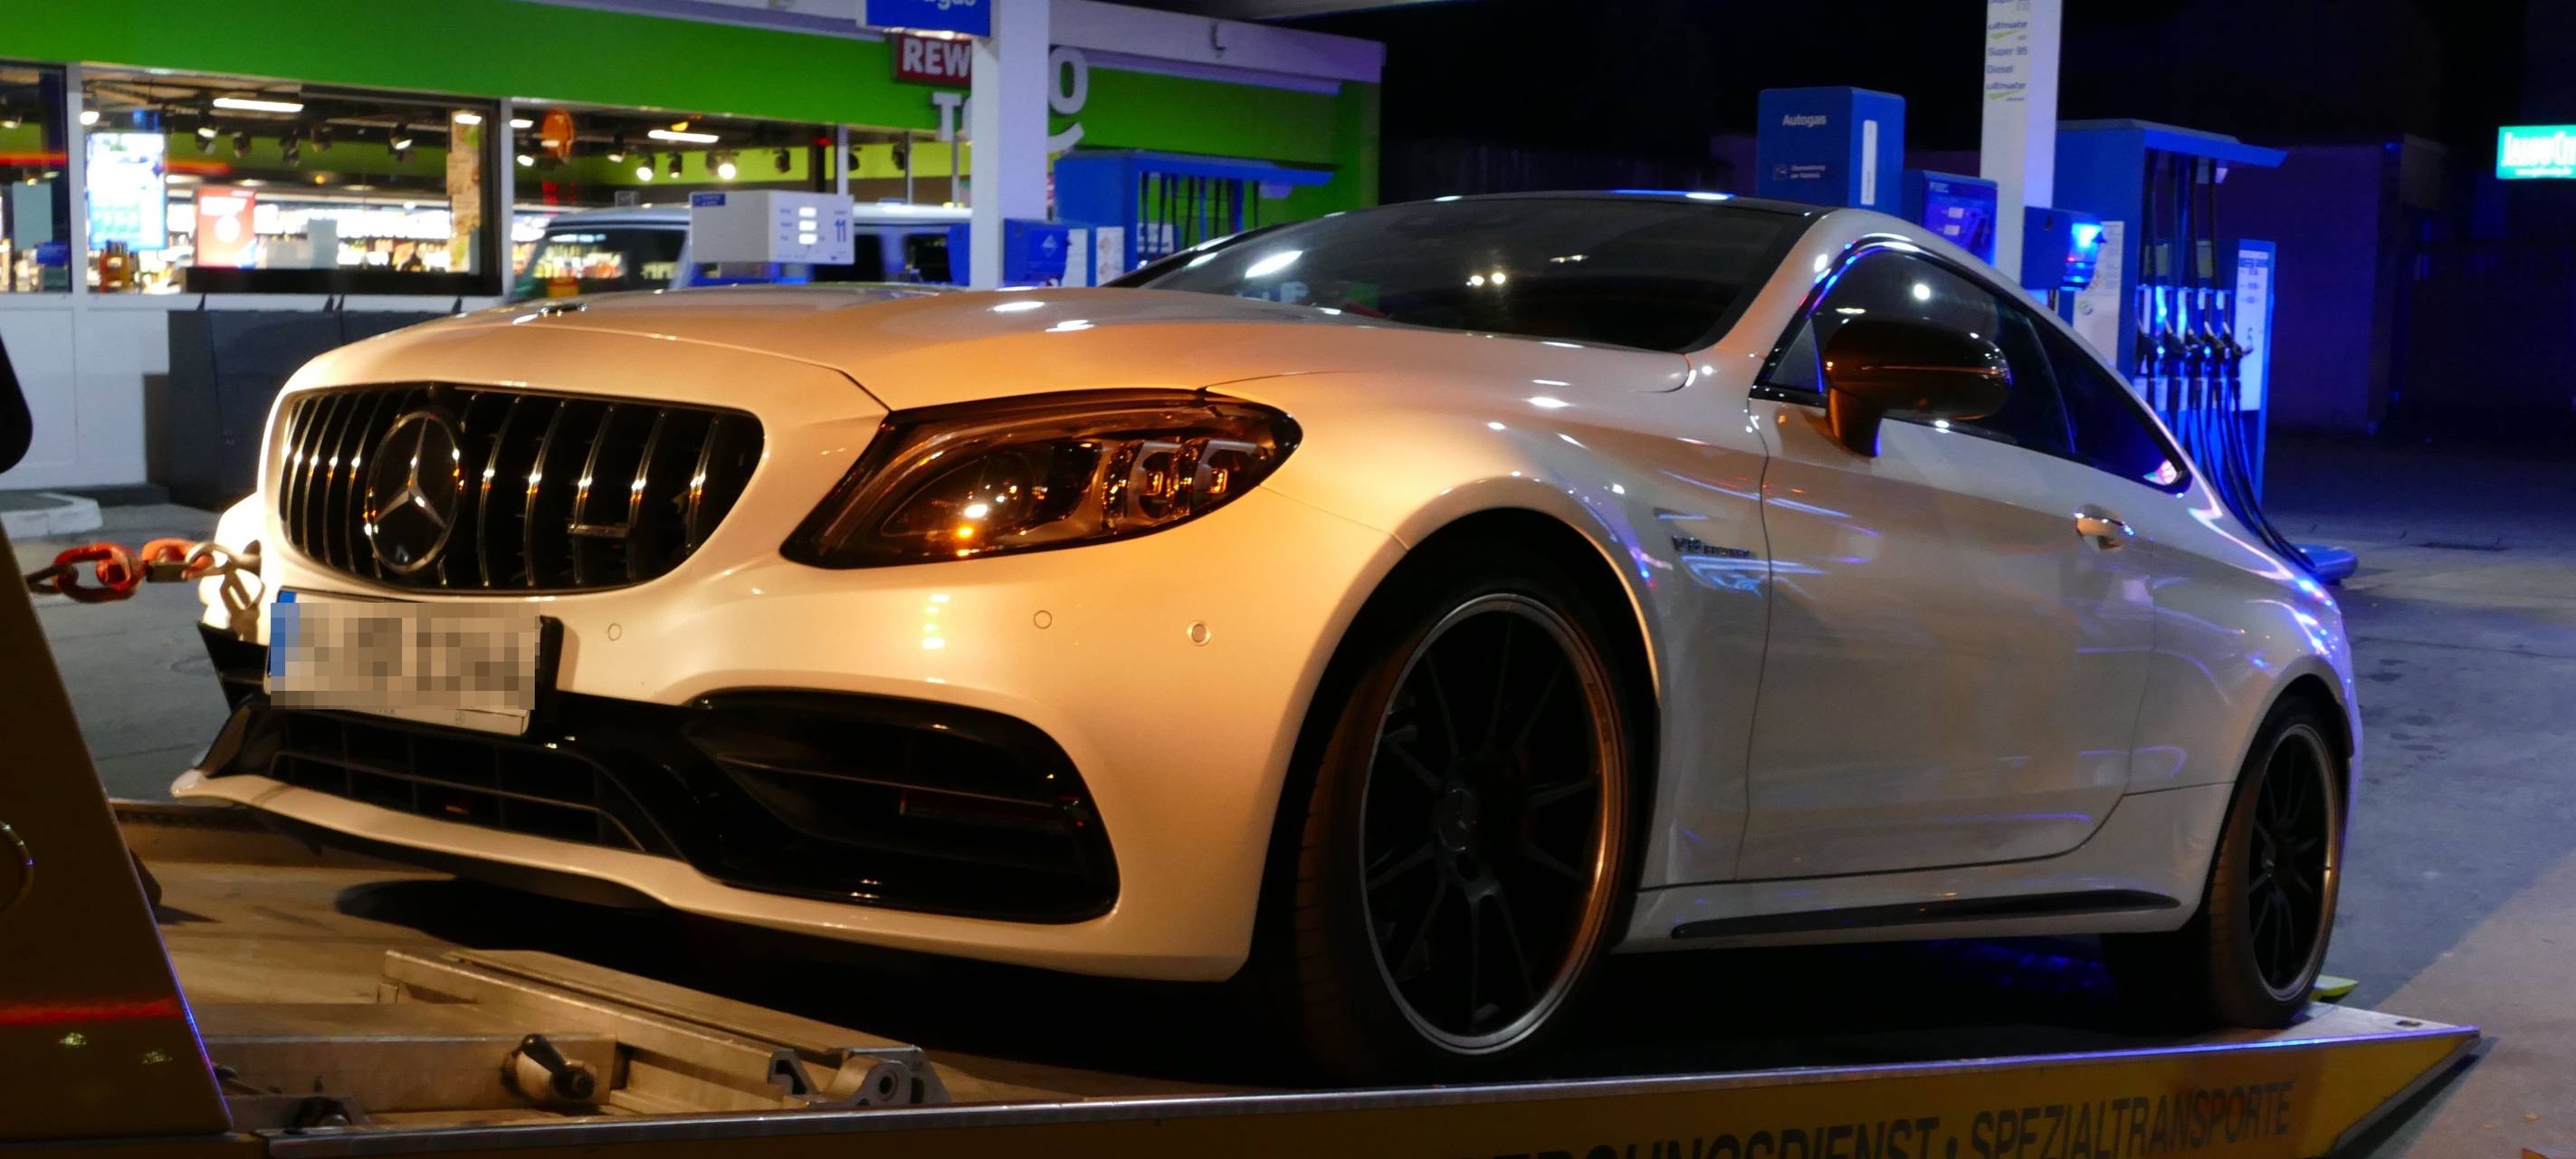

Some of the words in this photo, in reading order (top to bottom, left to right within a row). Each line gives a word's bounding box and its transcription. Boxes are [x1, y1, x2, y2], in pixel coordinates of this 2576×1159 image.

[903, 37, 971, 78] REW
[1986, 65, 2013, 73] Diesel
[933, 92, 971, 141] T
[1048, 46, 1088, 115] O
[1782, 114, 1827, 128] Autogas
[835, 219, 847, 243] 11
[1970, 1081, 2295, 1159] SPEZIALTRANSPORTE
